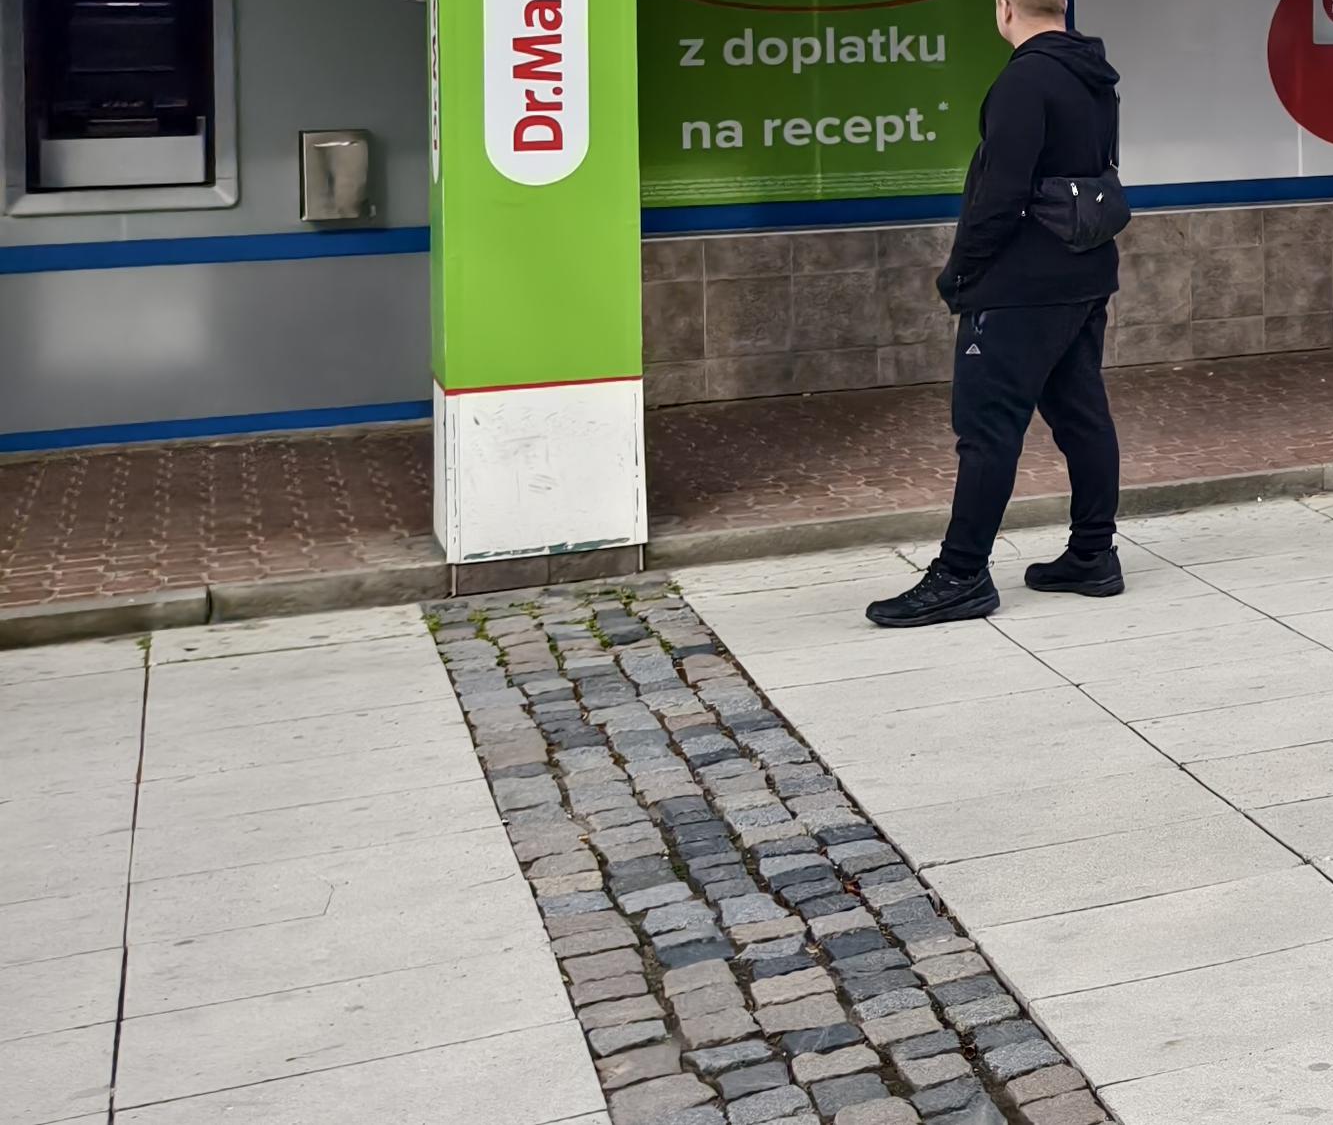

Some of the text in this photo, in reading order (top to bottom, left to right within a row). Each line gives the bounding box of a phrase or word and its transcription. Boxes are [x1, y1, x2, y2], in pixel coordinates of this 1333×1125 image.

[679, 26, 946, 74] z doplatku
[682, 117, 743, 149] na
